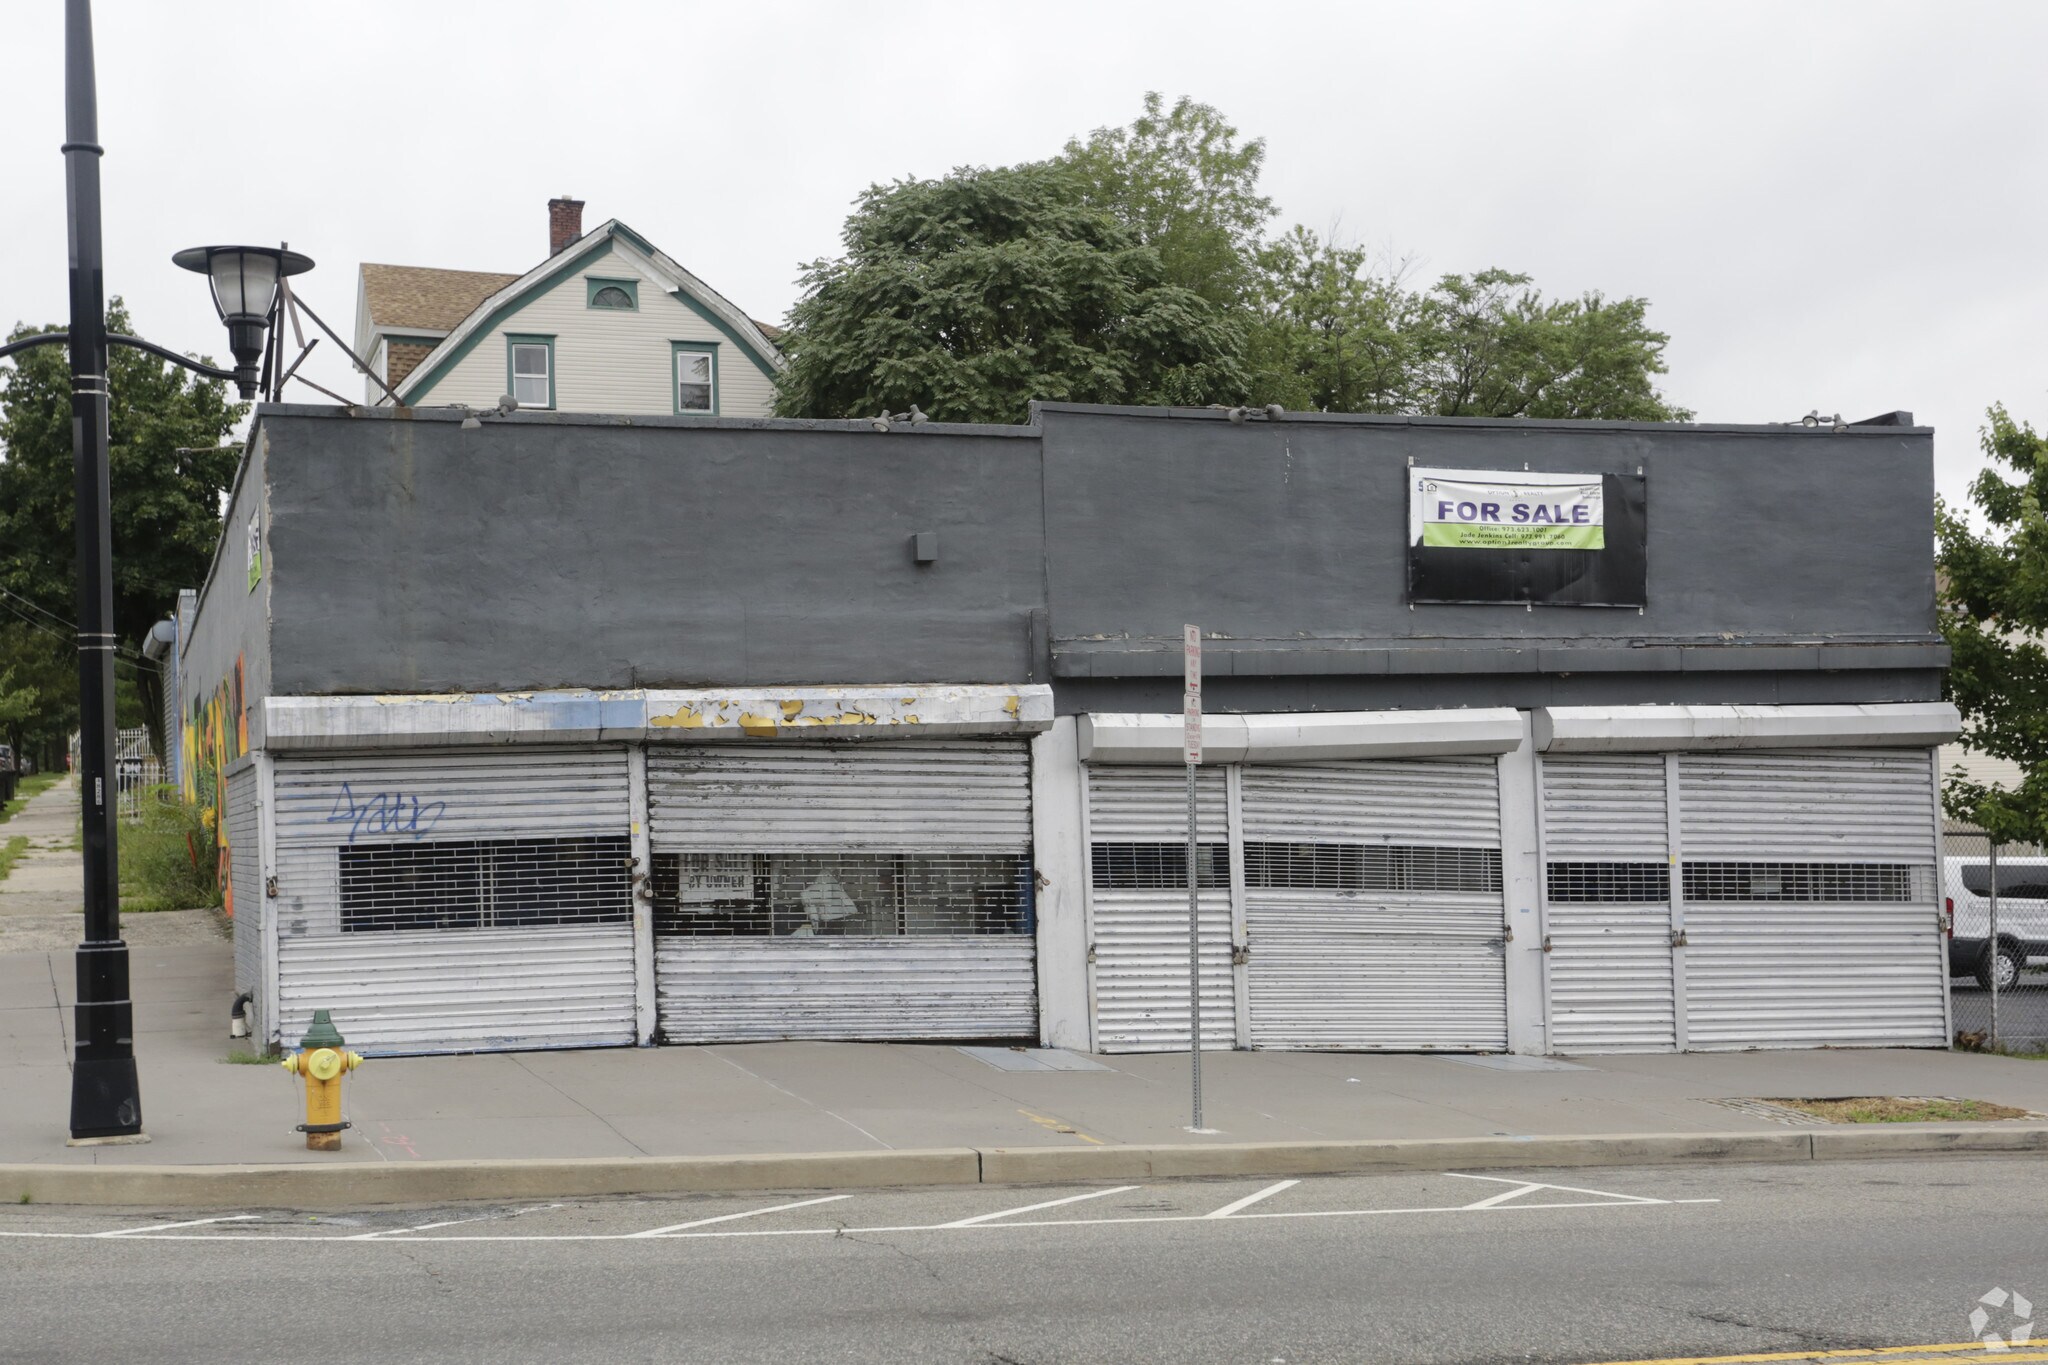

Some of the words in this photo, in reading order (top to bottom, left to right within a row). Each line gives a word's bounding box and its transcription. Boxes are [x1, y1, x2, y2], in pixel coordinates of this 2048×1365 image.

[1438, 501, 1501, 522] FOR
[1511, 504, 1590, 523] SALE
[706, 875, 745, 889] OWNER
